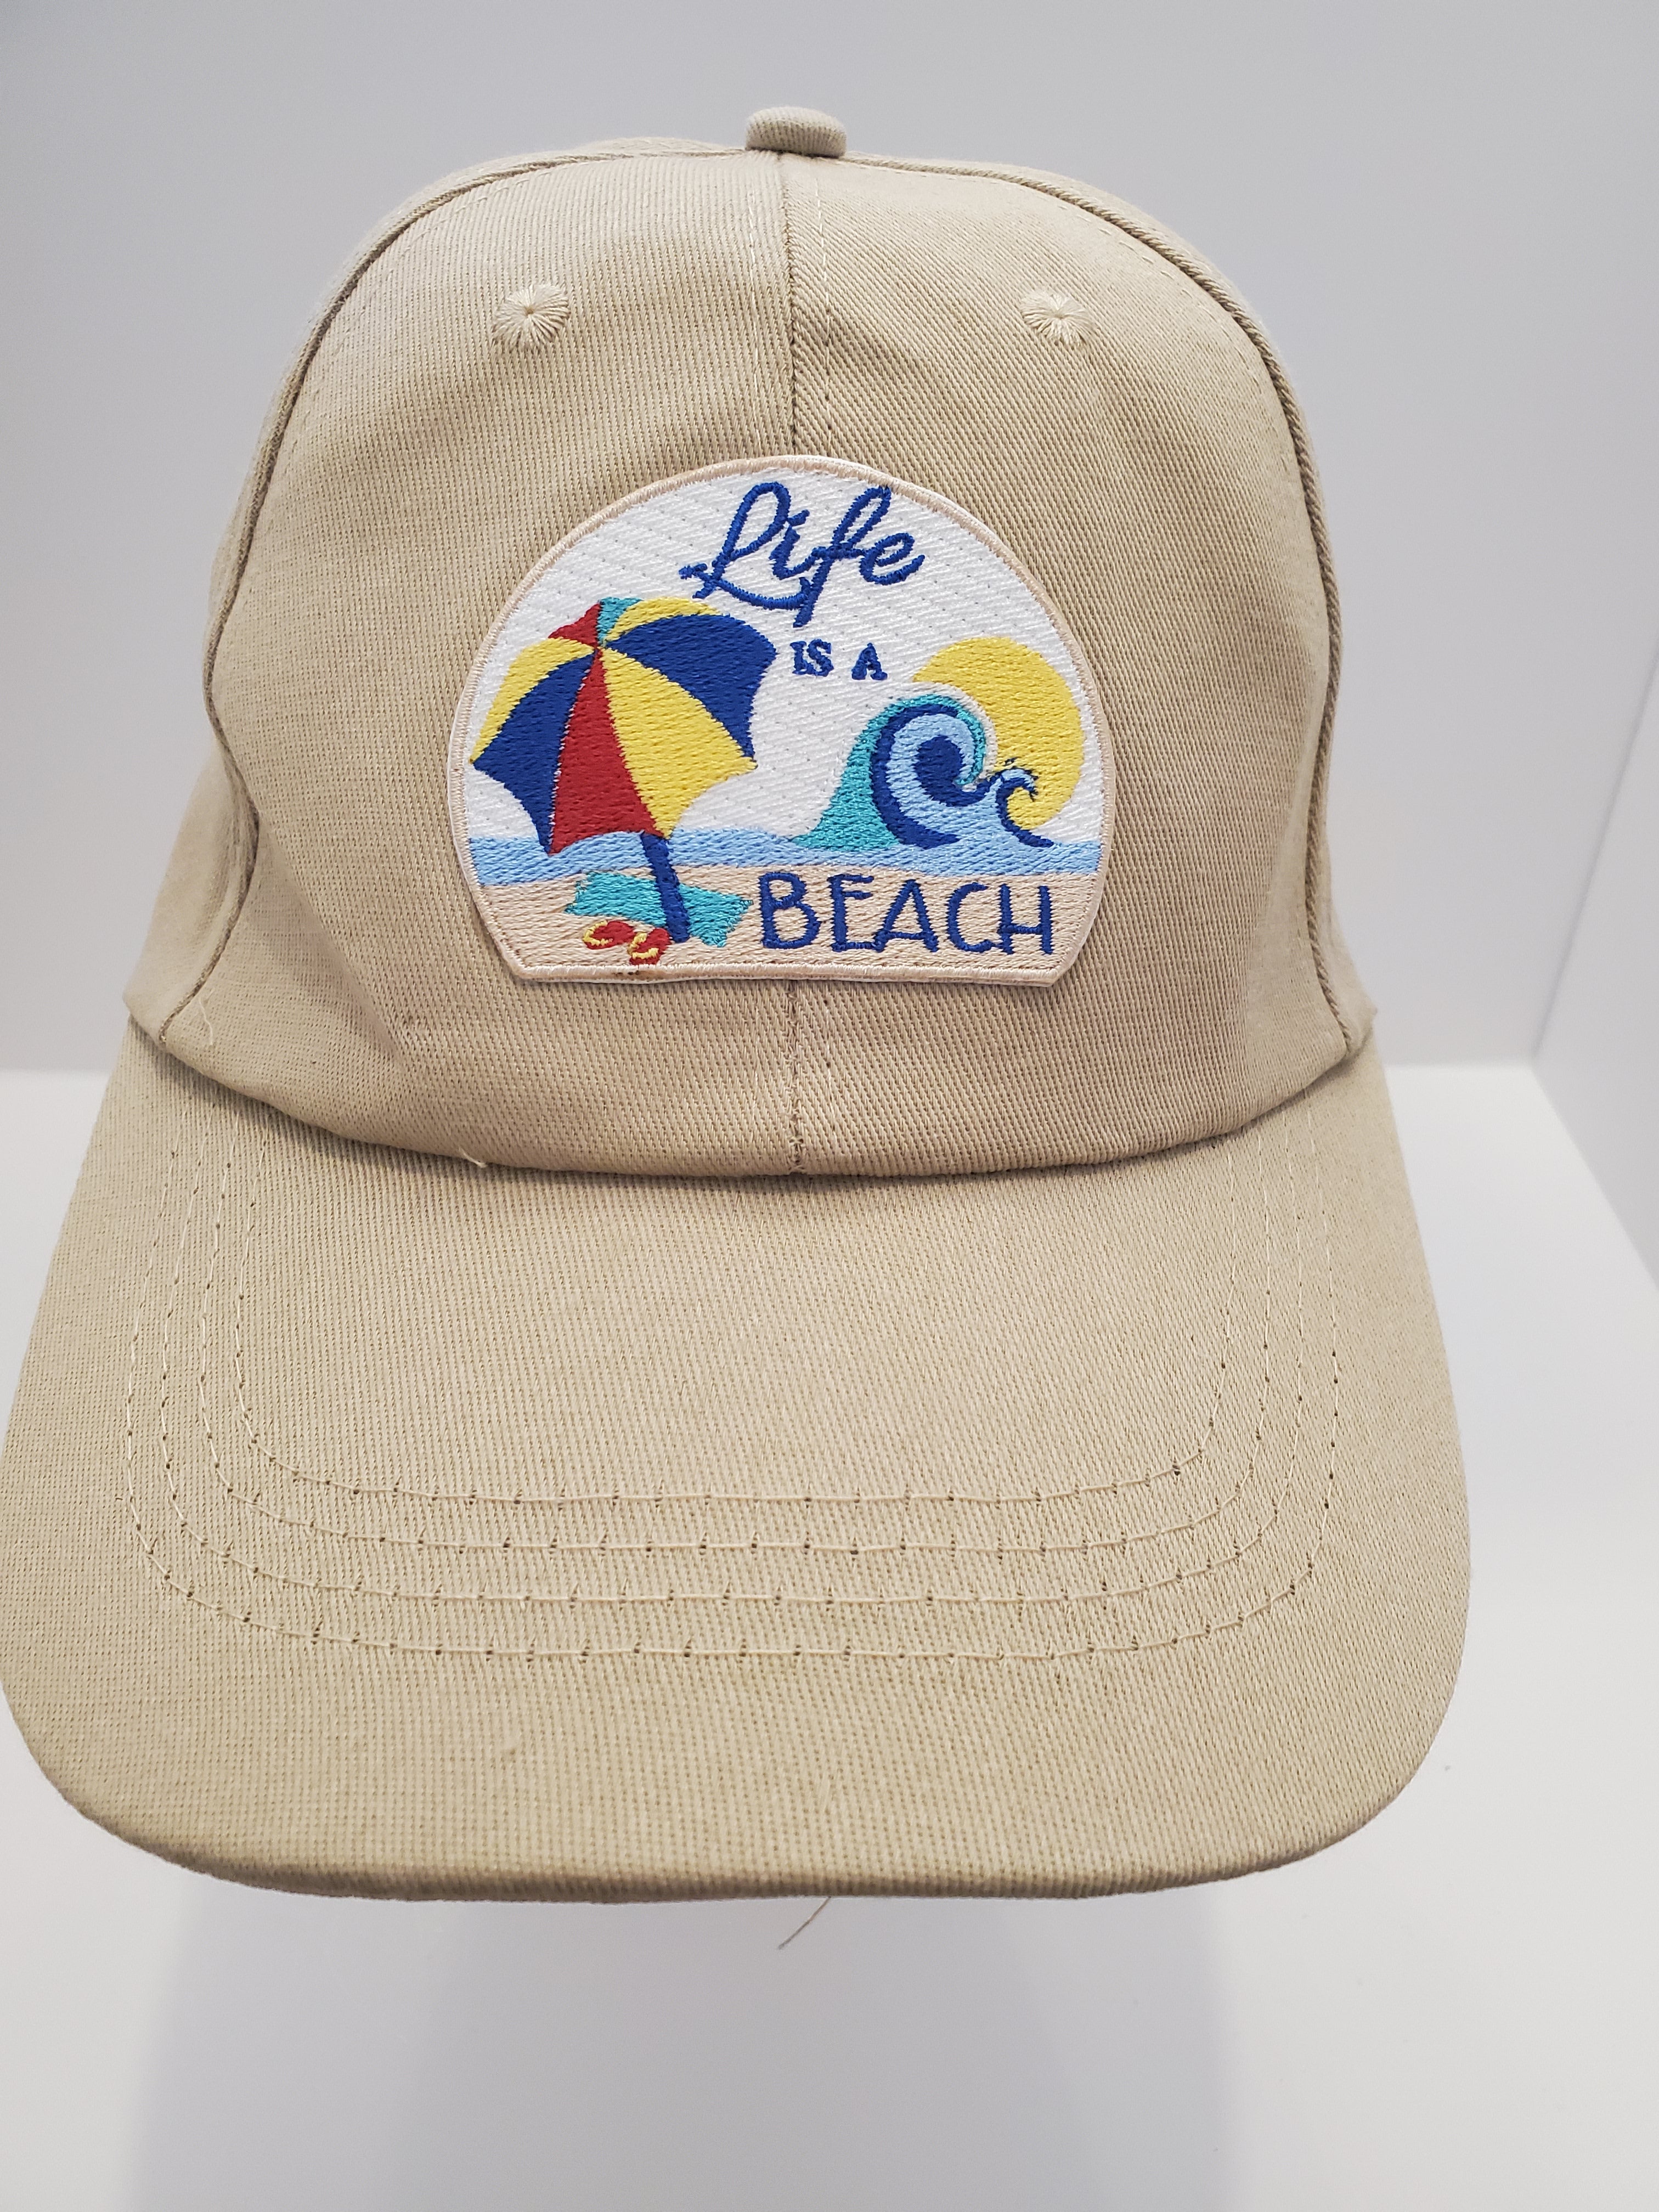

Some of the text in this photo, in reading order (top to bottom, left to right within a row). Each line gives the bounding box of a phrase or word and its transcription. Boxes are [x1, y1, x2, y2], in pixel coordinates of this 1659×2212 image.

[679, 481, 926, 628] Life
[789, 640, 888, 681] IS A
[759, 872, 1053, 955] BEACH
